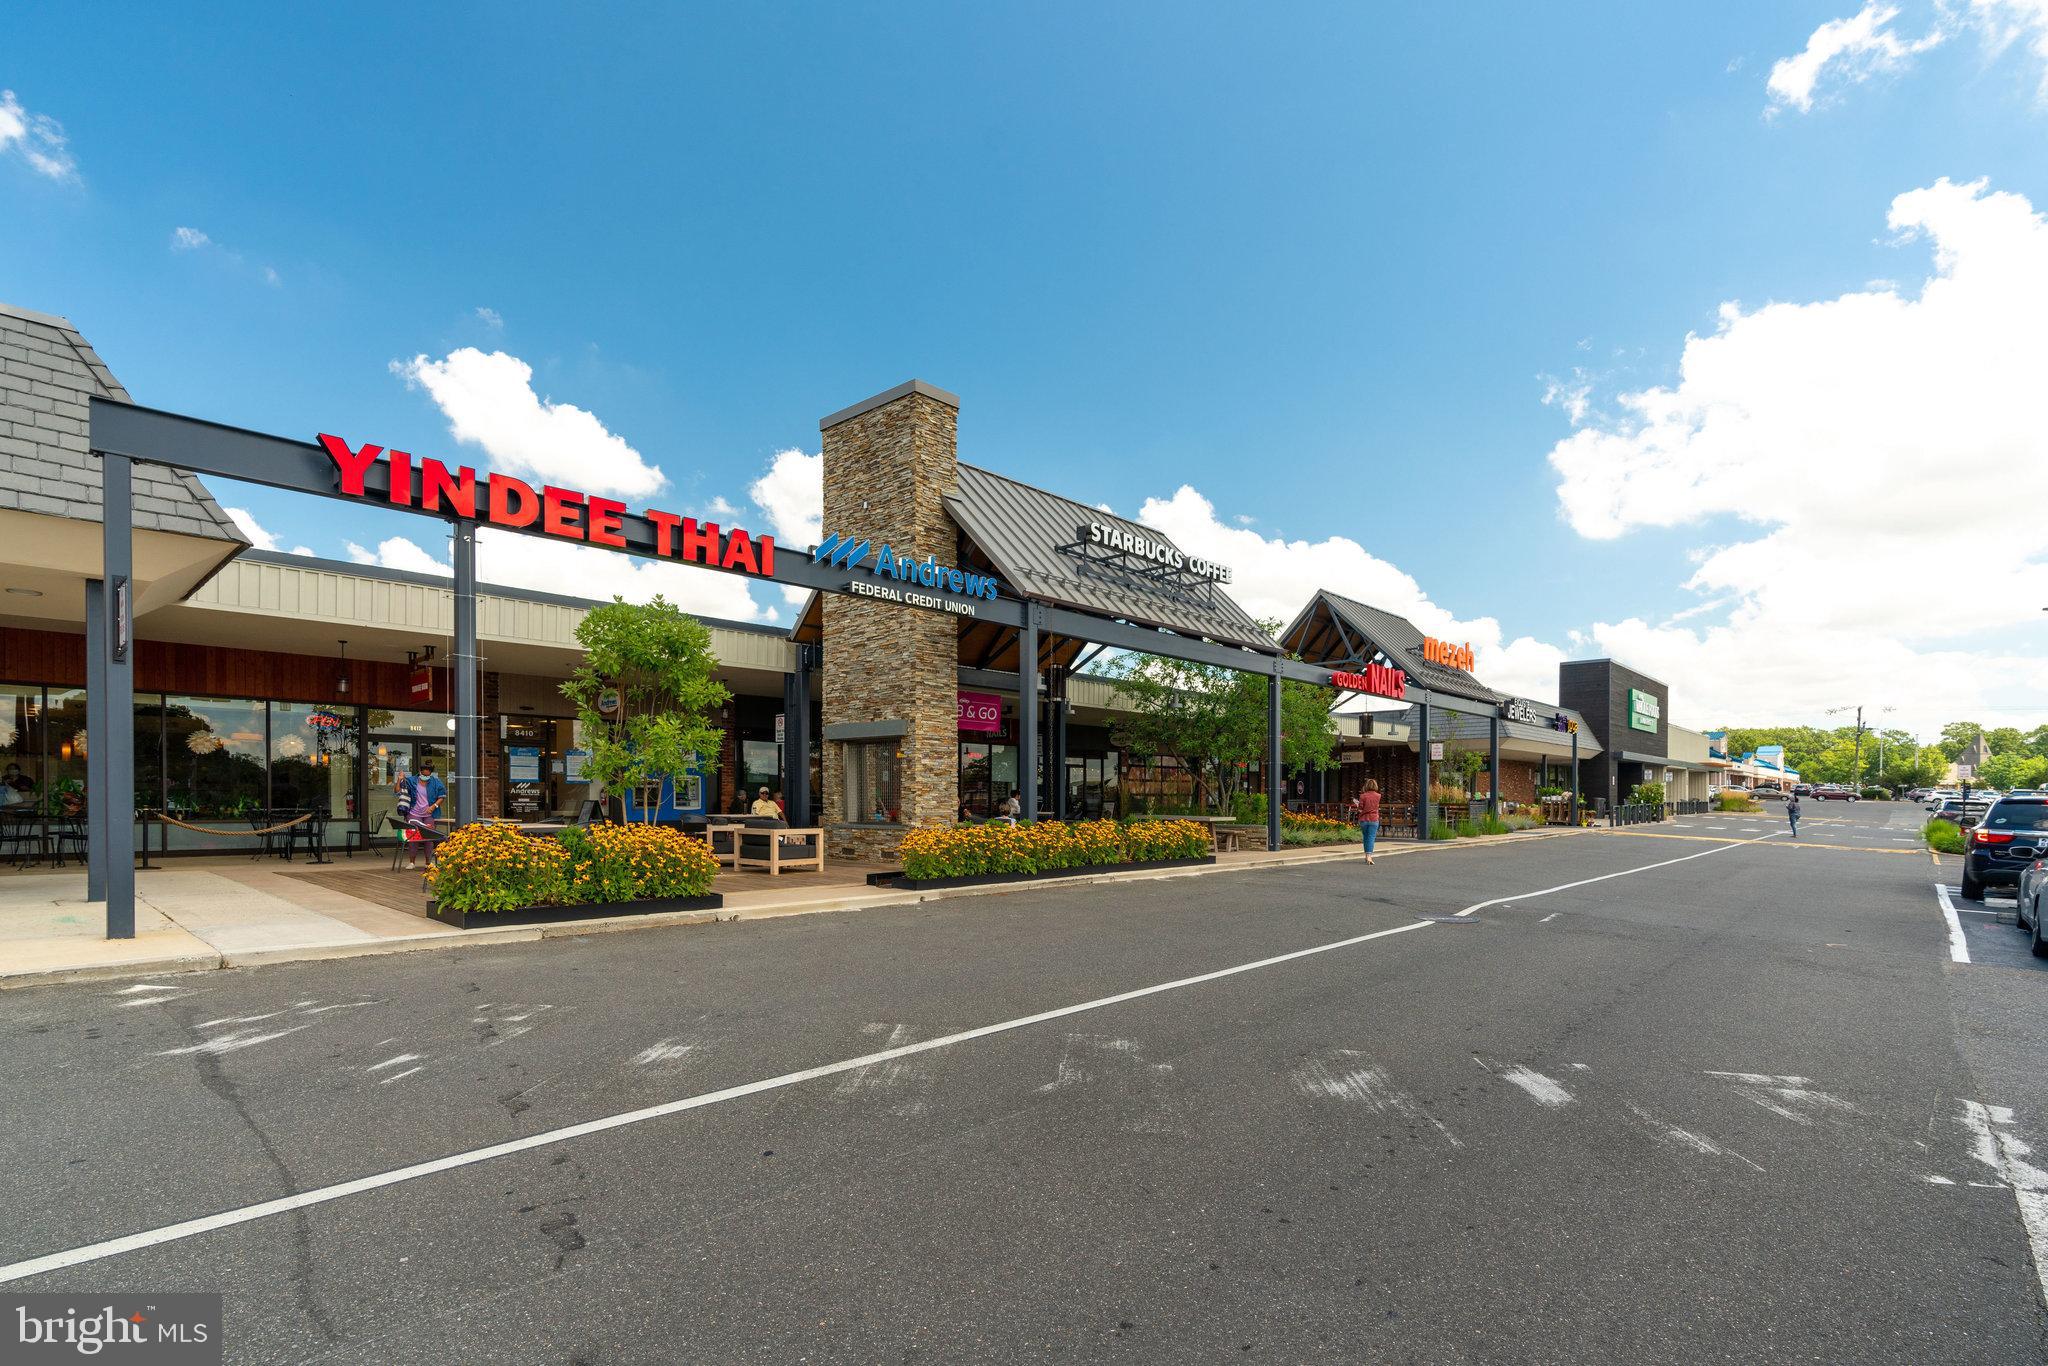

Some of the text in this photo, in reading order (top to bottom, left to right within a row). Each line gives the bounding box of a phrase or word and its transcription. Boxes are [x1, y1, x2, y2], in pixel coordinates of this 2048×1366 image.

[316, 432, 774, 577] YINDEE THAI
[1090, 522, 1233, 584] STARBUCKS COFFEE
[874, 544, 998, 601] Andrews
[851, 581, 975, 616] FEDERAL CREDIT UNION
[1424, 637, 1474, 672] mezeh
[1334, 663, 1405, 699] GOLDEN NAILS
[967, 705, 975, 719] &
[979, 706, 997, 720] GO
[1507, 703, 1537, 724] JEWELERS
[515, 729, 534, 737] 8410
